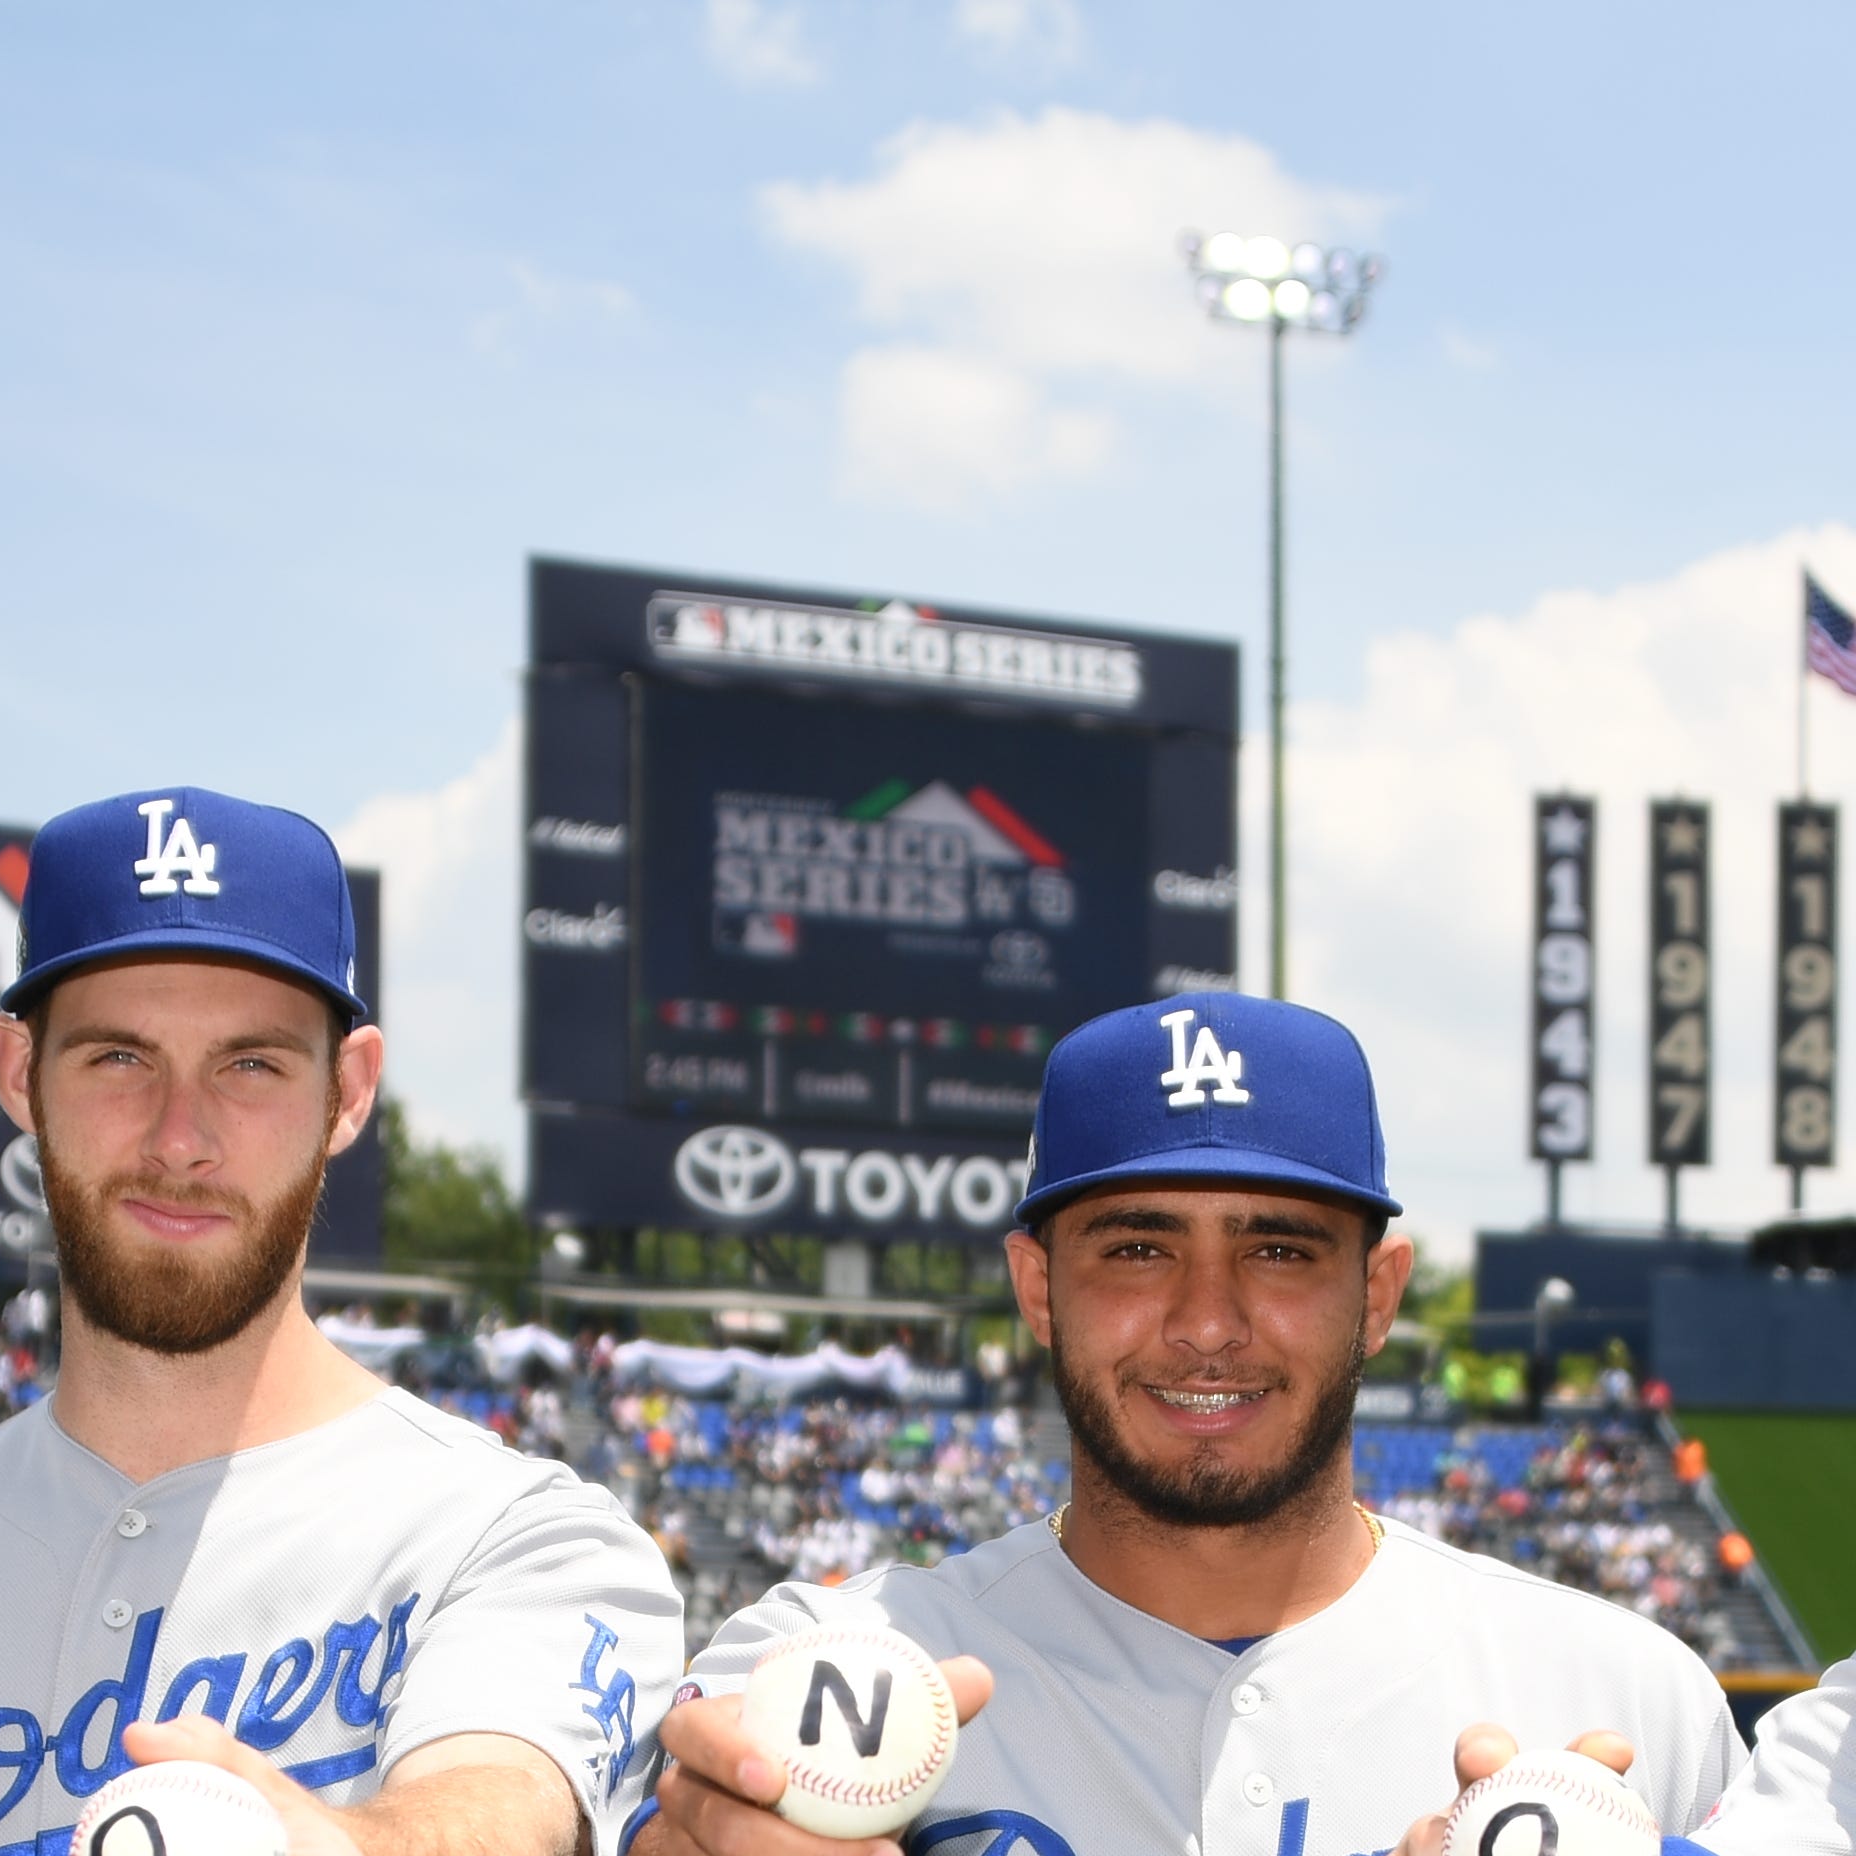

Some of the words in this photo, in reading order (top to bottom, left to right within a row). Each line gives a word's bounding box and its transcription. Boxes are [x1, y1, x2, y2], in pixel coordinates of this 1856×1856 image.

[726, 604, 945, 675] MEXICO
[952, 630, 1140, 701] SERIES
[135, 799, 220, 894] LA
[715, 808, 967, 870] MEXICO
[714, 855, 968, 926] SERIES
[1538, 859, 1591, 1153] 1943
[1655, 870, 1707, 1163] 1947
[1781, 870, 1835, 1156] 1948
[1160, 1010, 1249, 1106] LA
[800, 1148, 1030, 1225] TOYO
[798, 1658, 894, 1758] N
